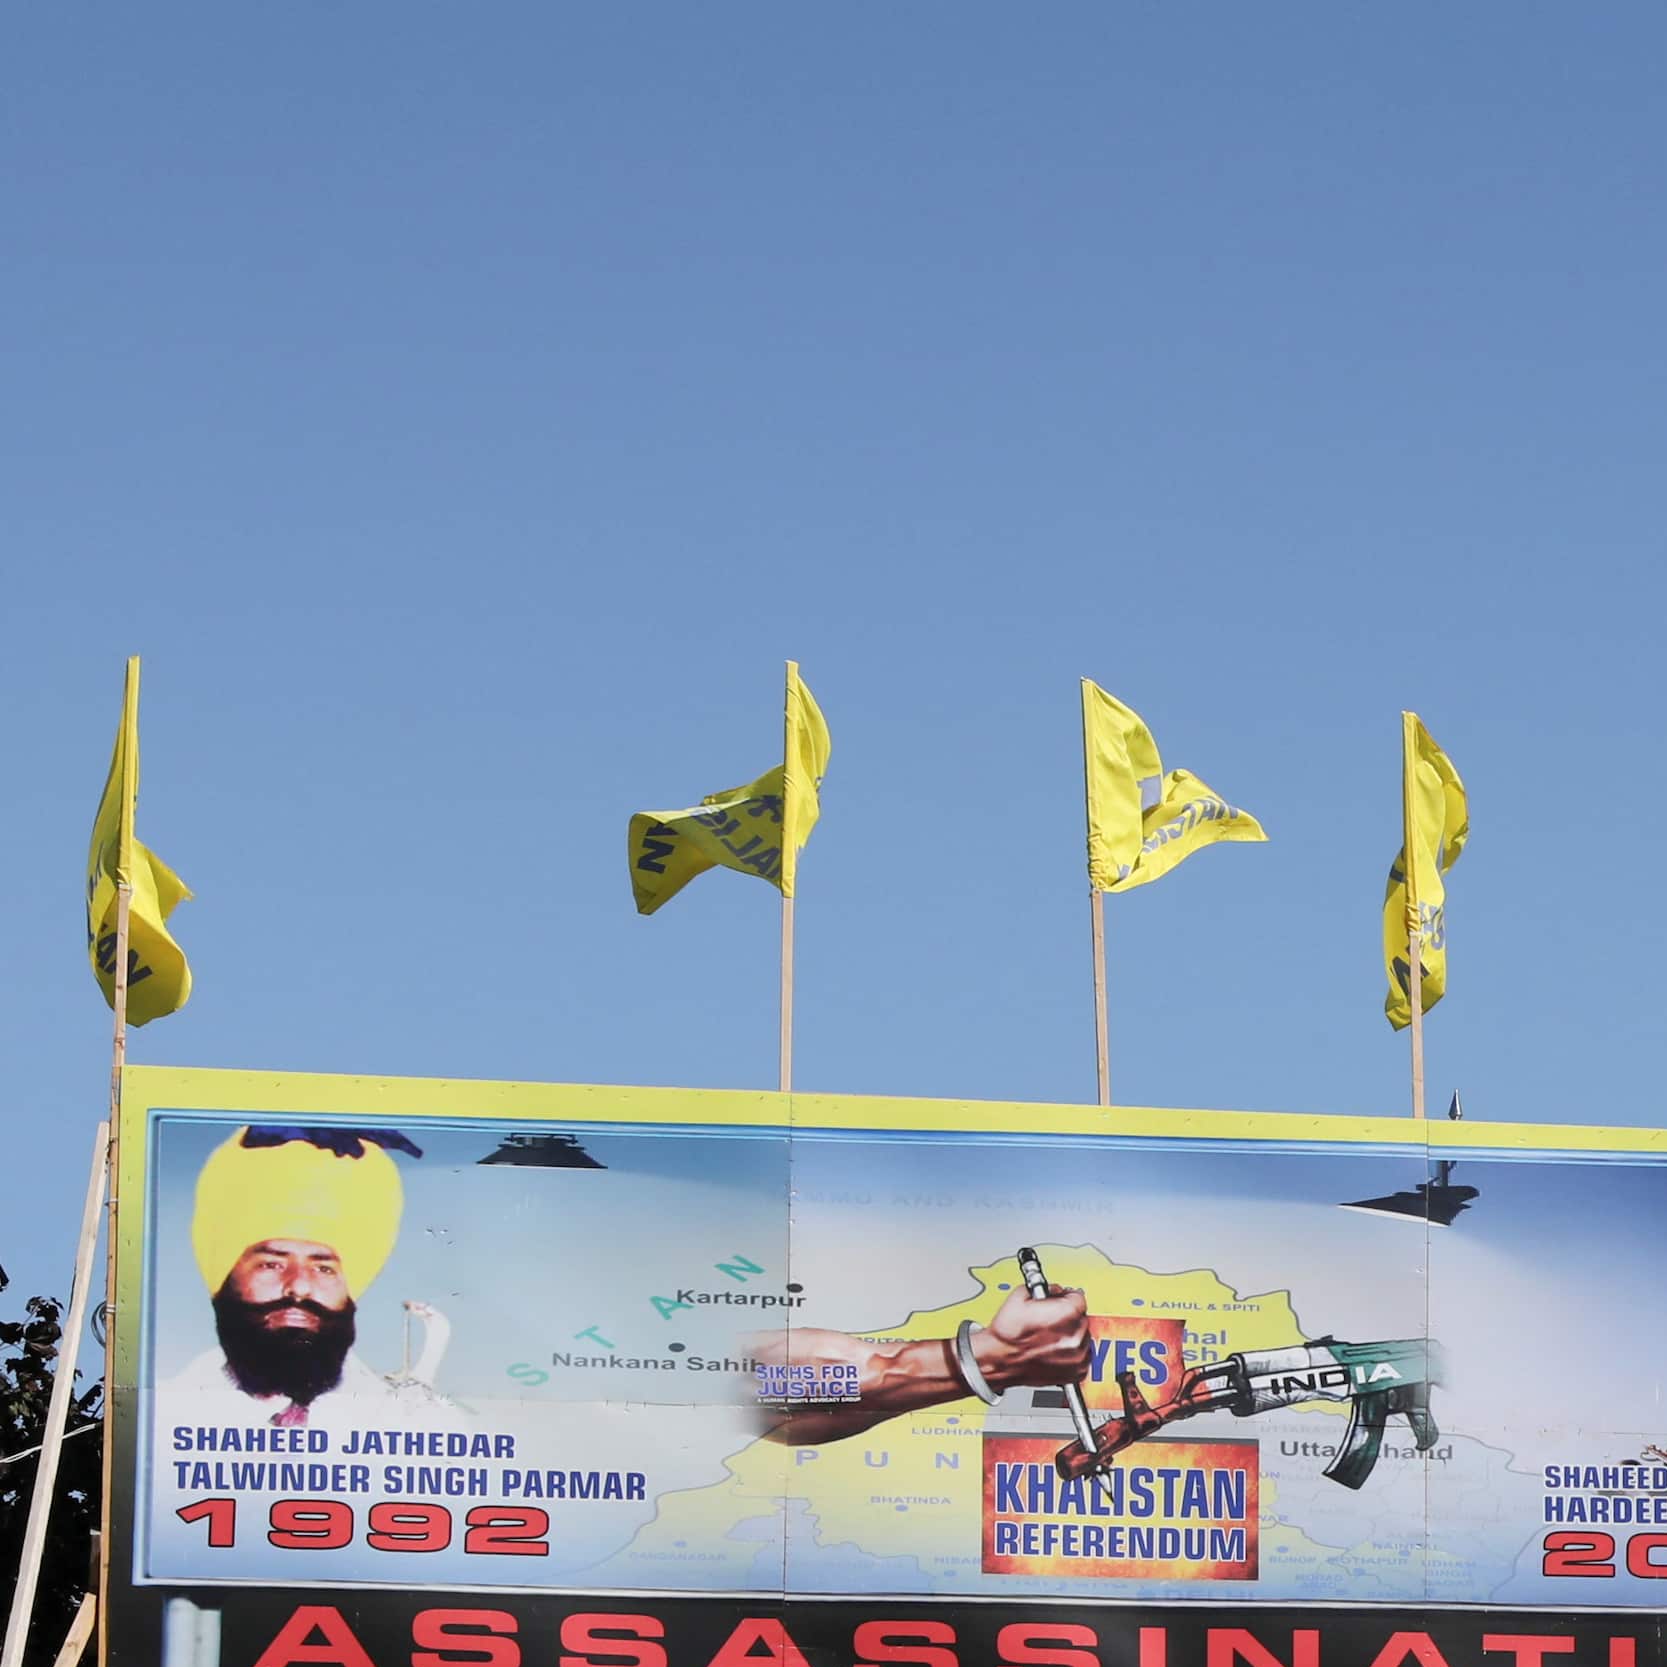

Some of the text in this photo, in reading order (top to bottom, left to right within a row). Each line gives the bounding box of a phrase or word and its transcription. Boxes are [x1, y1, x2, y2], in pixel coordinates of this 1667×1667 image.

[676, 1288, 806, 1309] Kartarpur
[1151, 1301, 1261, 1312] LAHUL & SPITI
[552, 1352, 763, 1375] Nankana Sahib
[757, 1366, 858, 1380] SIKHS FOR
[1088, 1340, 1168, 1385] YES
[757, 1381, 859, 1397] JUSTICE
[1271, 1361, 1402, 1395] INDIA
[174, 1425, 516, 1458] SHAHEED JATHEDAR
[911, 1426, 983, 1437] LUDHIAN
[1279, 1440, 1454, 1460] Uttahand
[174, 1460, 647, 1501] TALWINDER SINGH PARMAR
[996, 1463, 1246, 1519] KHALISTAN
[176, 1498, 550, 1556] 1992
[995, 1522, 1246, 1561] REFERENDUM
